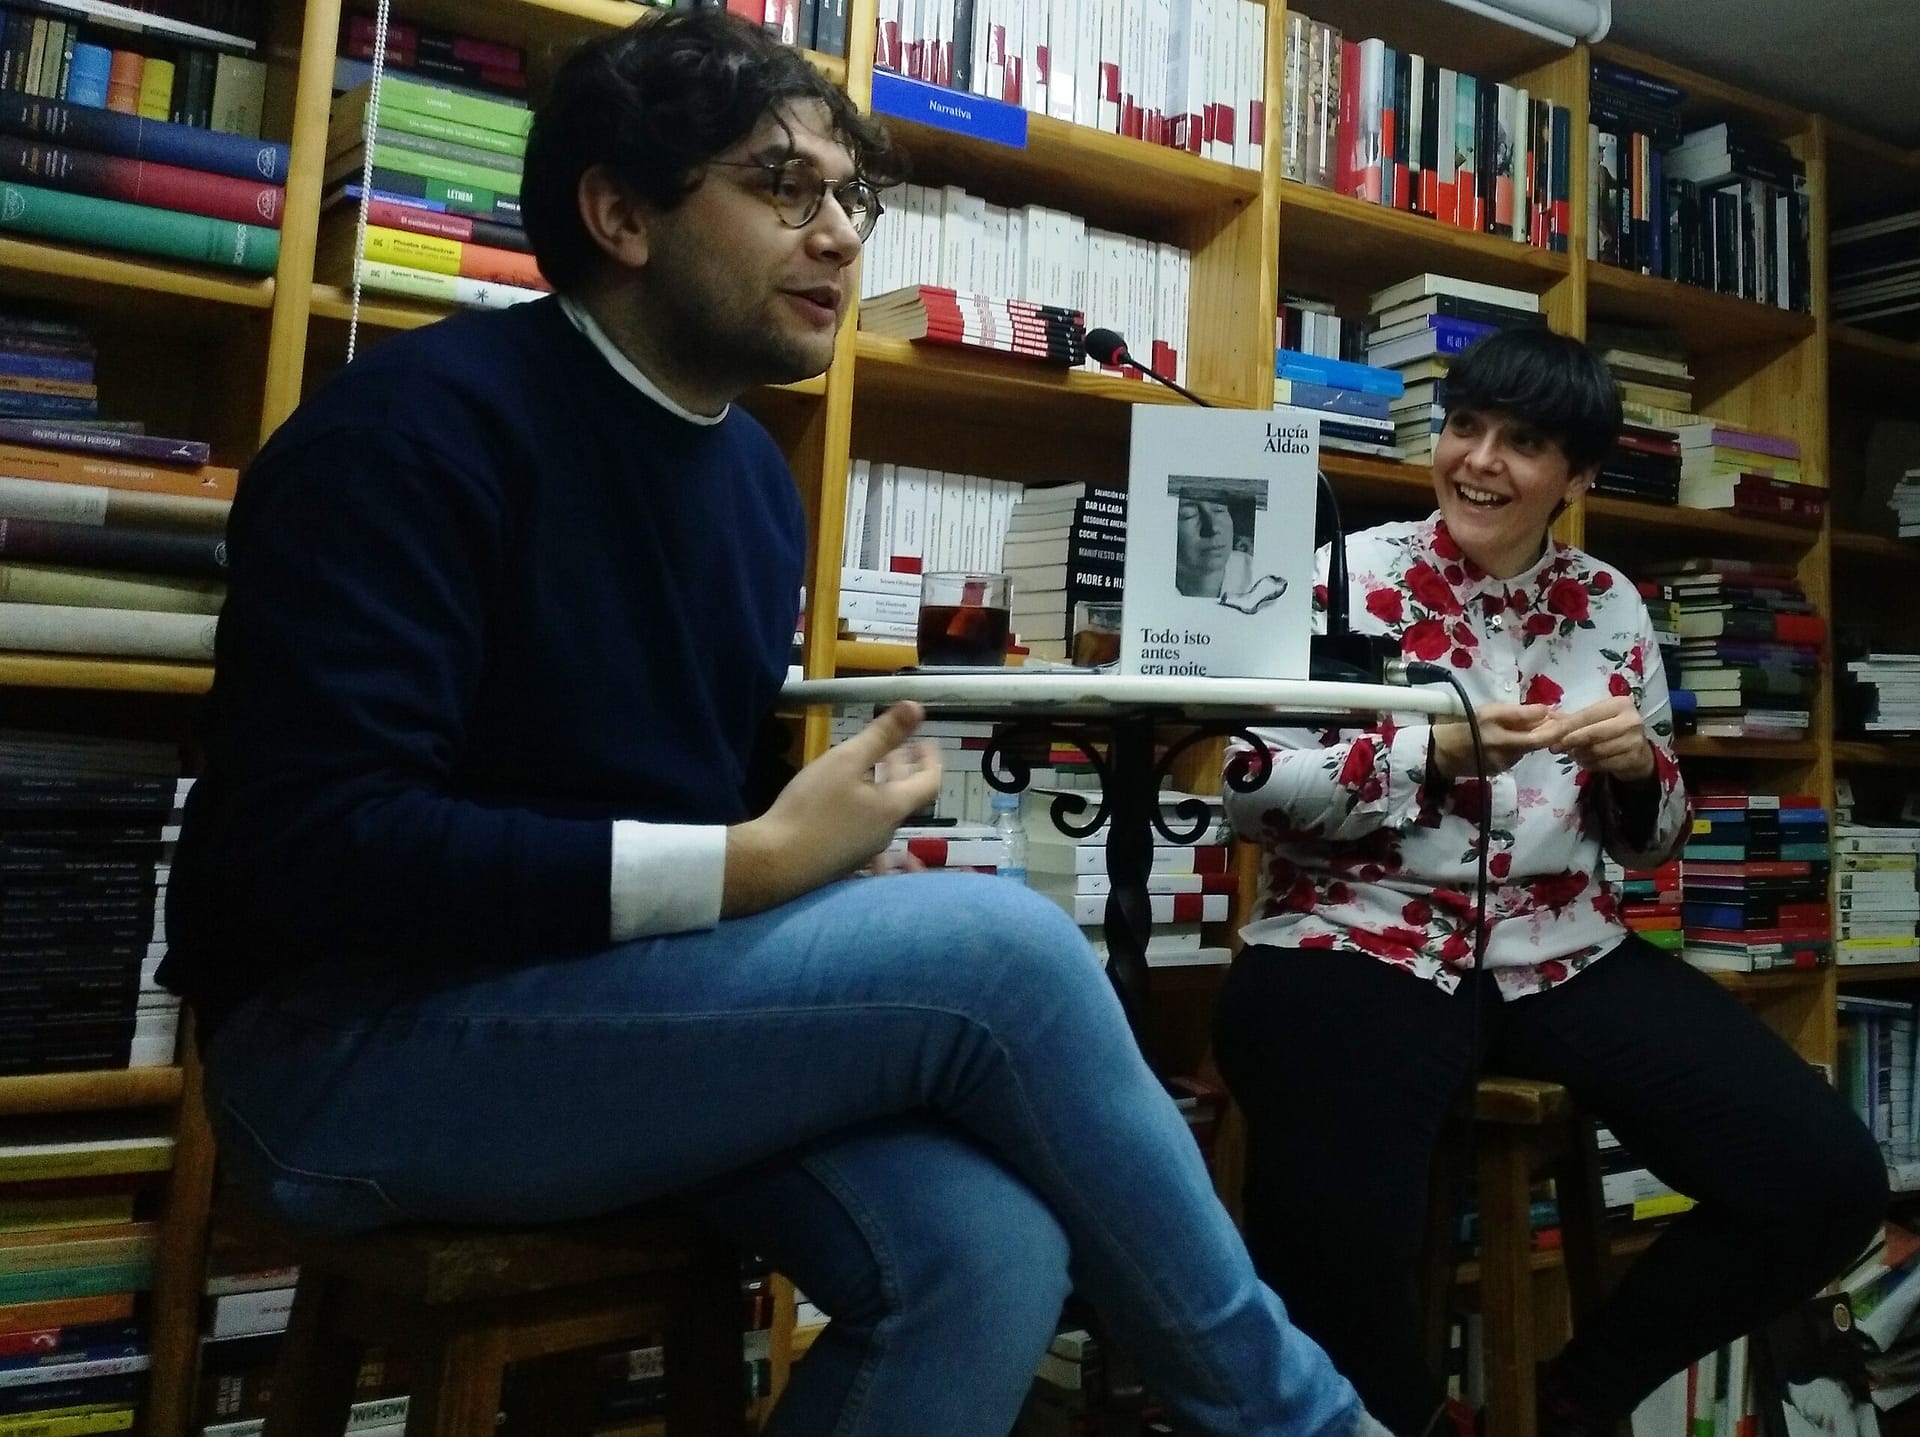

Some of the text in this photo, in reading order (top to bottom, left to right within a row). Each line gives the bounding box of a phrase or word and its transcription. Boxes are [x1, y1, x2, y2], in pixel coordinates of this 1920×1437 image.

[929, 100, 972, 120] Narrativa
[1265, 423, 1308, 439] Lucía
[1264, 438, 1310, 454] Aldao
[1085, 500, 1123, 514] DAR LA CARA
[1079, 529, 1098, 540] COCHE
[1079, 547, 1115, 560] MANIFIESTO
[1076, 572, 1103, 587] PADRE
[1104, 576, 1111, 588] &
[1140, 628, 1211, 645] Todo isto
[1141, 647, 1180, 660] antes
[1140, 661, 1207, 677] era noite
